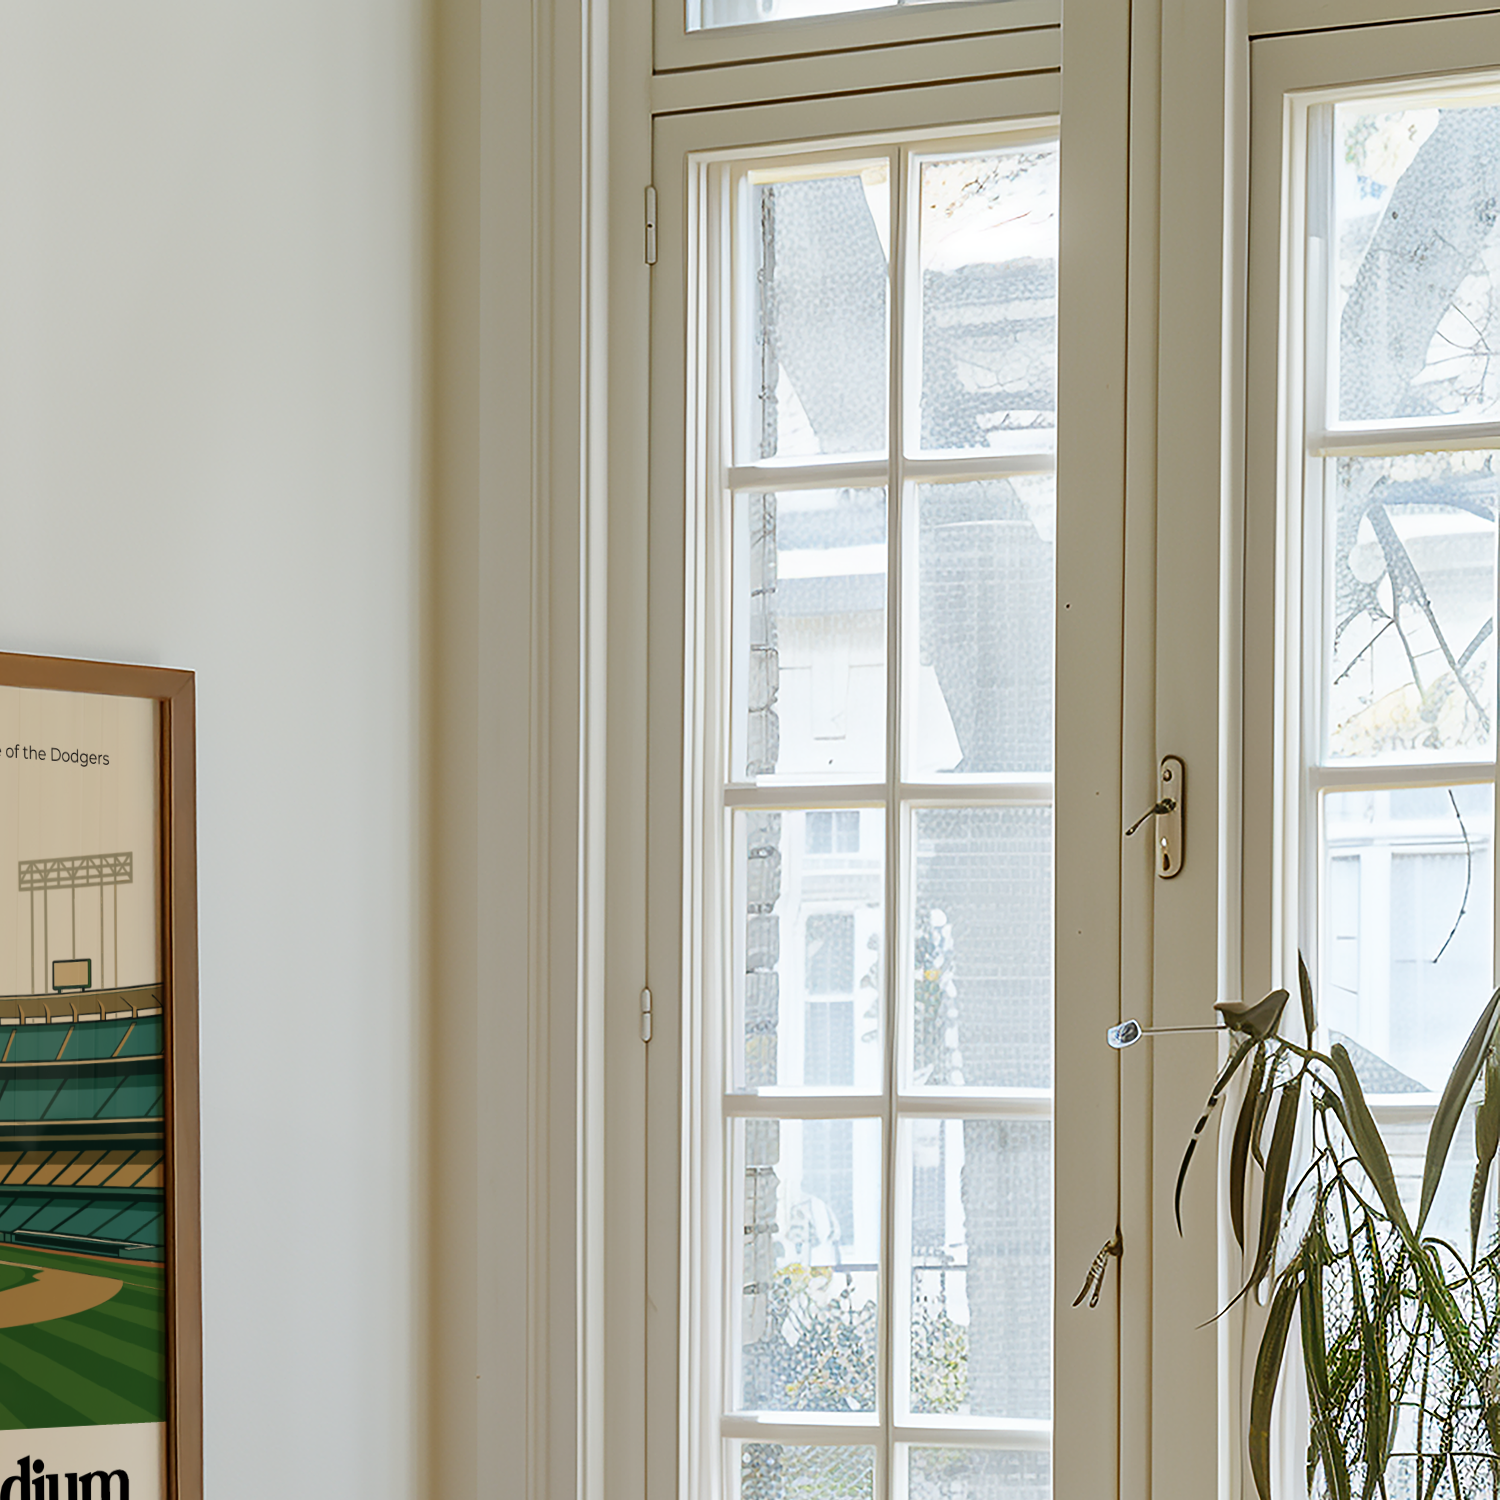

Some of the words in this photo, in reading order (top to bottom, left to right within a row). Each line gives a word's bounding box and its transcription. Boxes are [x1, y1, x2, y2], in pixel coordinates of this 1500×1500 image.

[5, 743, 19, 759] of
[22, 745, 46, 761] the
[50, 747, 110, 768] Dodgers
